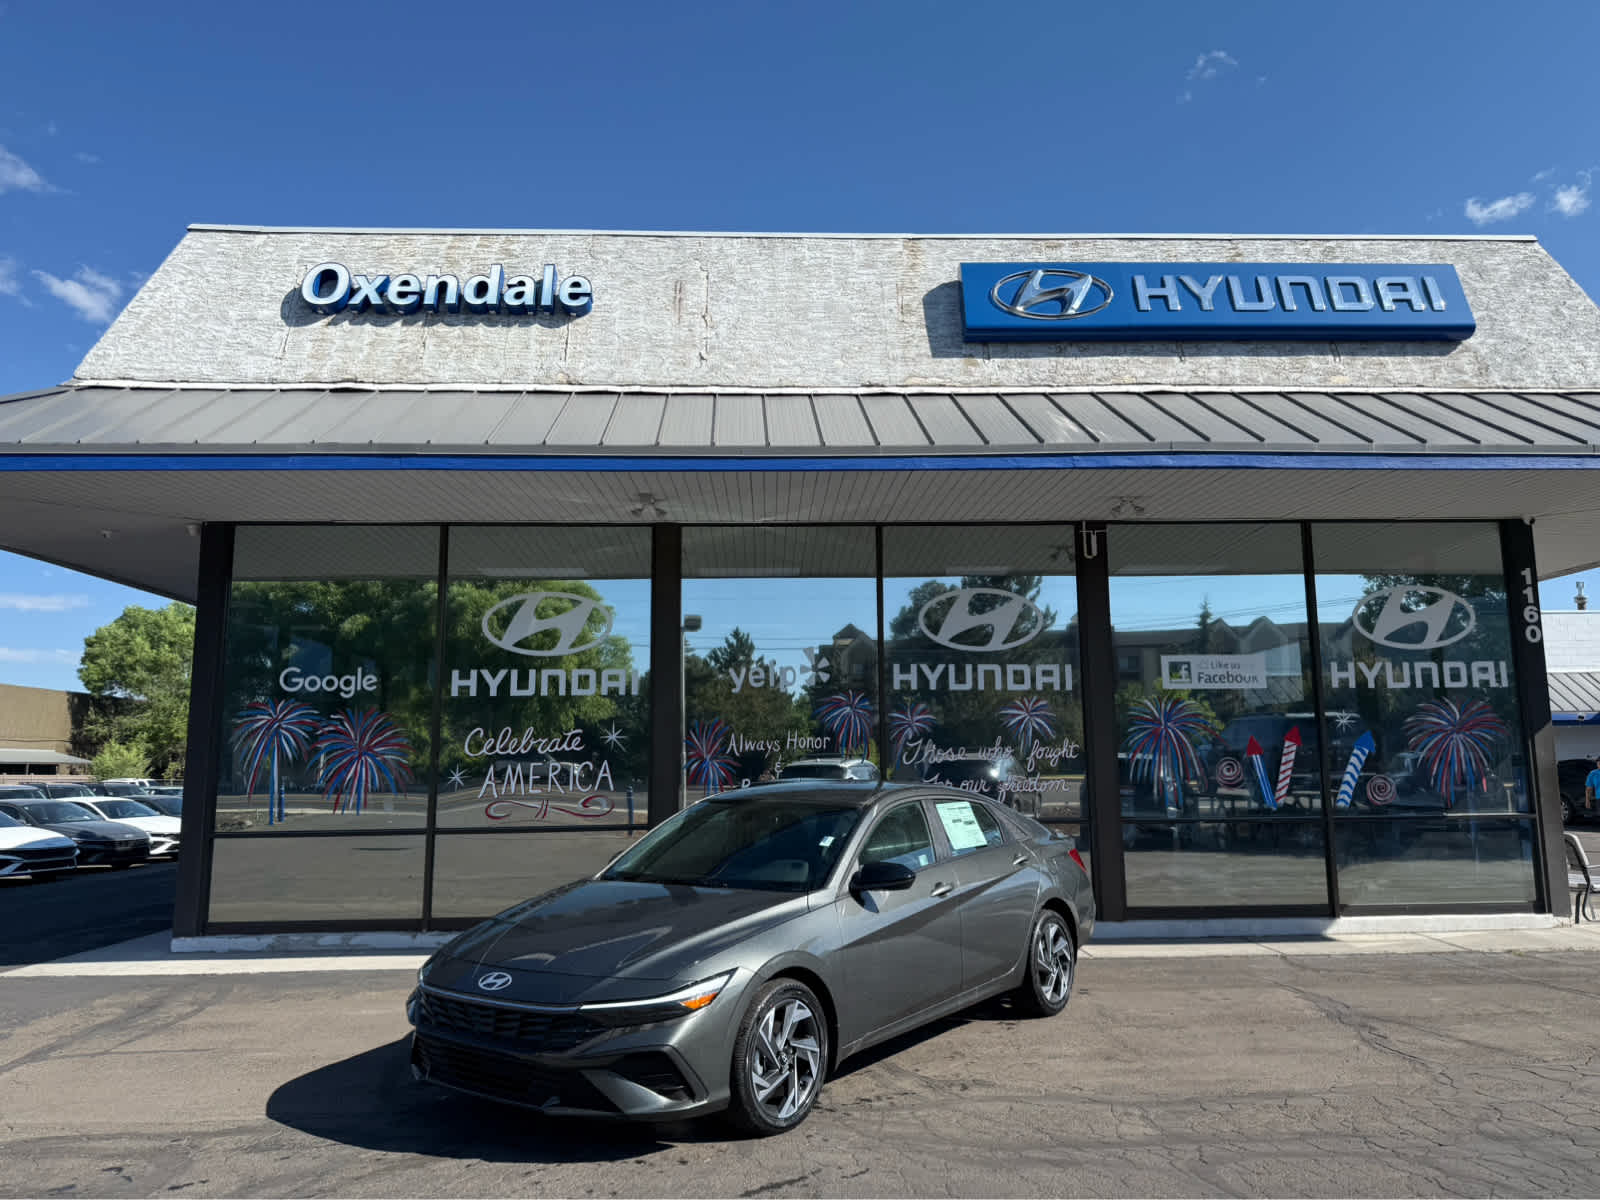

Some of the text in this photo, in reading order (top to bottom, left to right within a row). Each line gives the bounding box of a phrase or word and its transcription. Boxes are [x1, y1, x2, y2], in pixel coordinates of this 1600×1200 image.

[301, 262, 593, 310] Oxendale
[1132, 274, 1447, 313] HYUNDAI
[1520, 567, 1542, 643] 1160
[280, 666, 377, 698] Google
[451, 669, 640, 697] HYUNDAI
[729, 659, 796, 693] yelp
[893, 663, 1073, 691] HYUNDAI
[1330, 660, 1509, 689] HYUNDAI
[464, 726, 585, 757] Celebrate
[726, 729, 831, 759] Always Honor
[902, 735, 1080, 772] Those who fought
[478, 759, 615, 799] AMERICA
[960, 778, 991, 793] our
[998, 772, 1072, 803] freedom
